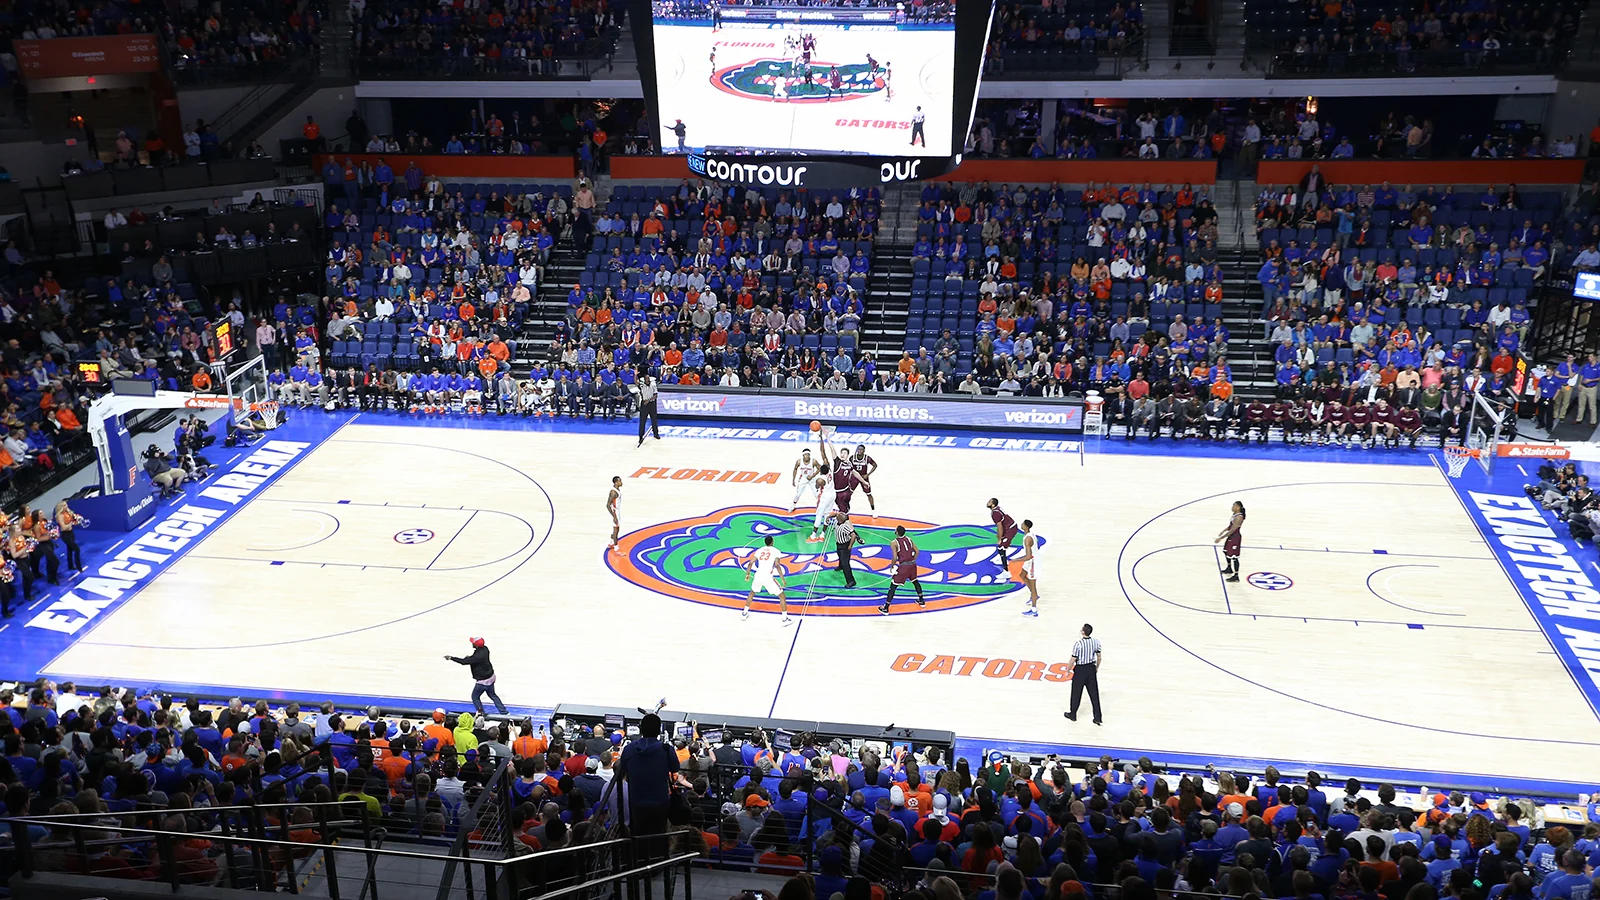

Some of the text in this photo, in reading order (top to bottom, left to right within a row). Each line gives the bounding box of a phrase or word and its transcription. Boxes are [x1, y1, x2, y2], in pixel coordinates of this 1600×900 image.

[835, 119, 910, 130] GATORS
[218, 333, 232, 356] 30
[84, 371, 98, 382] 30
[662, 397, 720, 412] verizon
[794, 400, 934, 420] Better matters.
[1004, 409, 1068, 424] verizon
[658, 425, 777, 440] STEPHEN
[968, 437, 1082, 452] CENTER
[128, 465, 137, 488] F
[628, 466, 781, 484] FLORIDA
[24, 440, 312, 635] EXACTECH ARENA
[903, 540, 908, 551] 1
[759, 551, 771, 561] 23
[1467, 490, 1600, 621] EXACTECH
[889, 652, 1075, 682] GATORS
